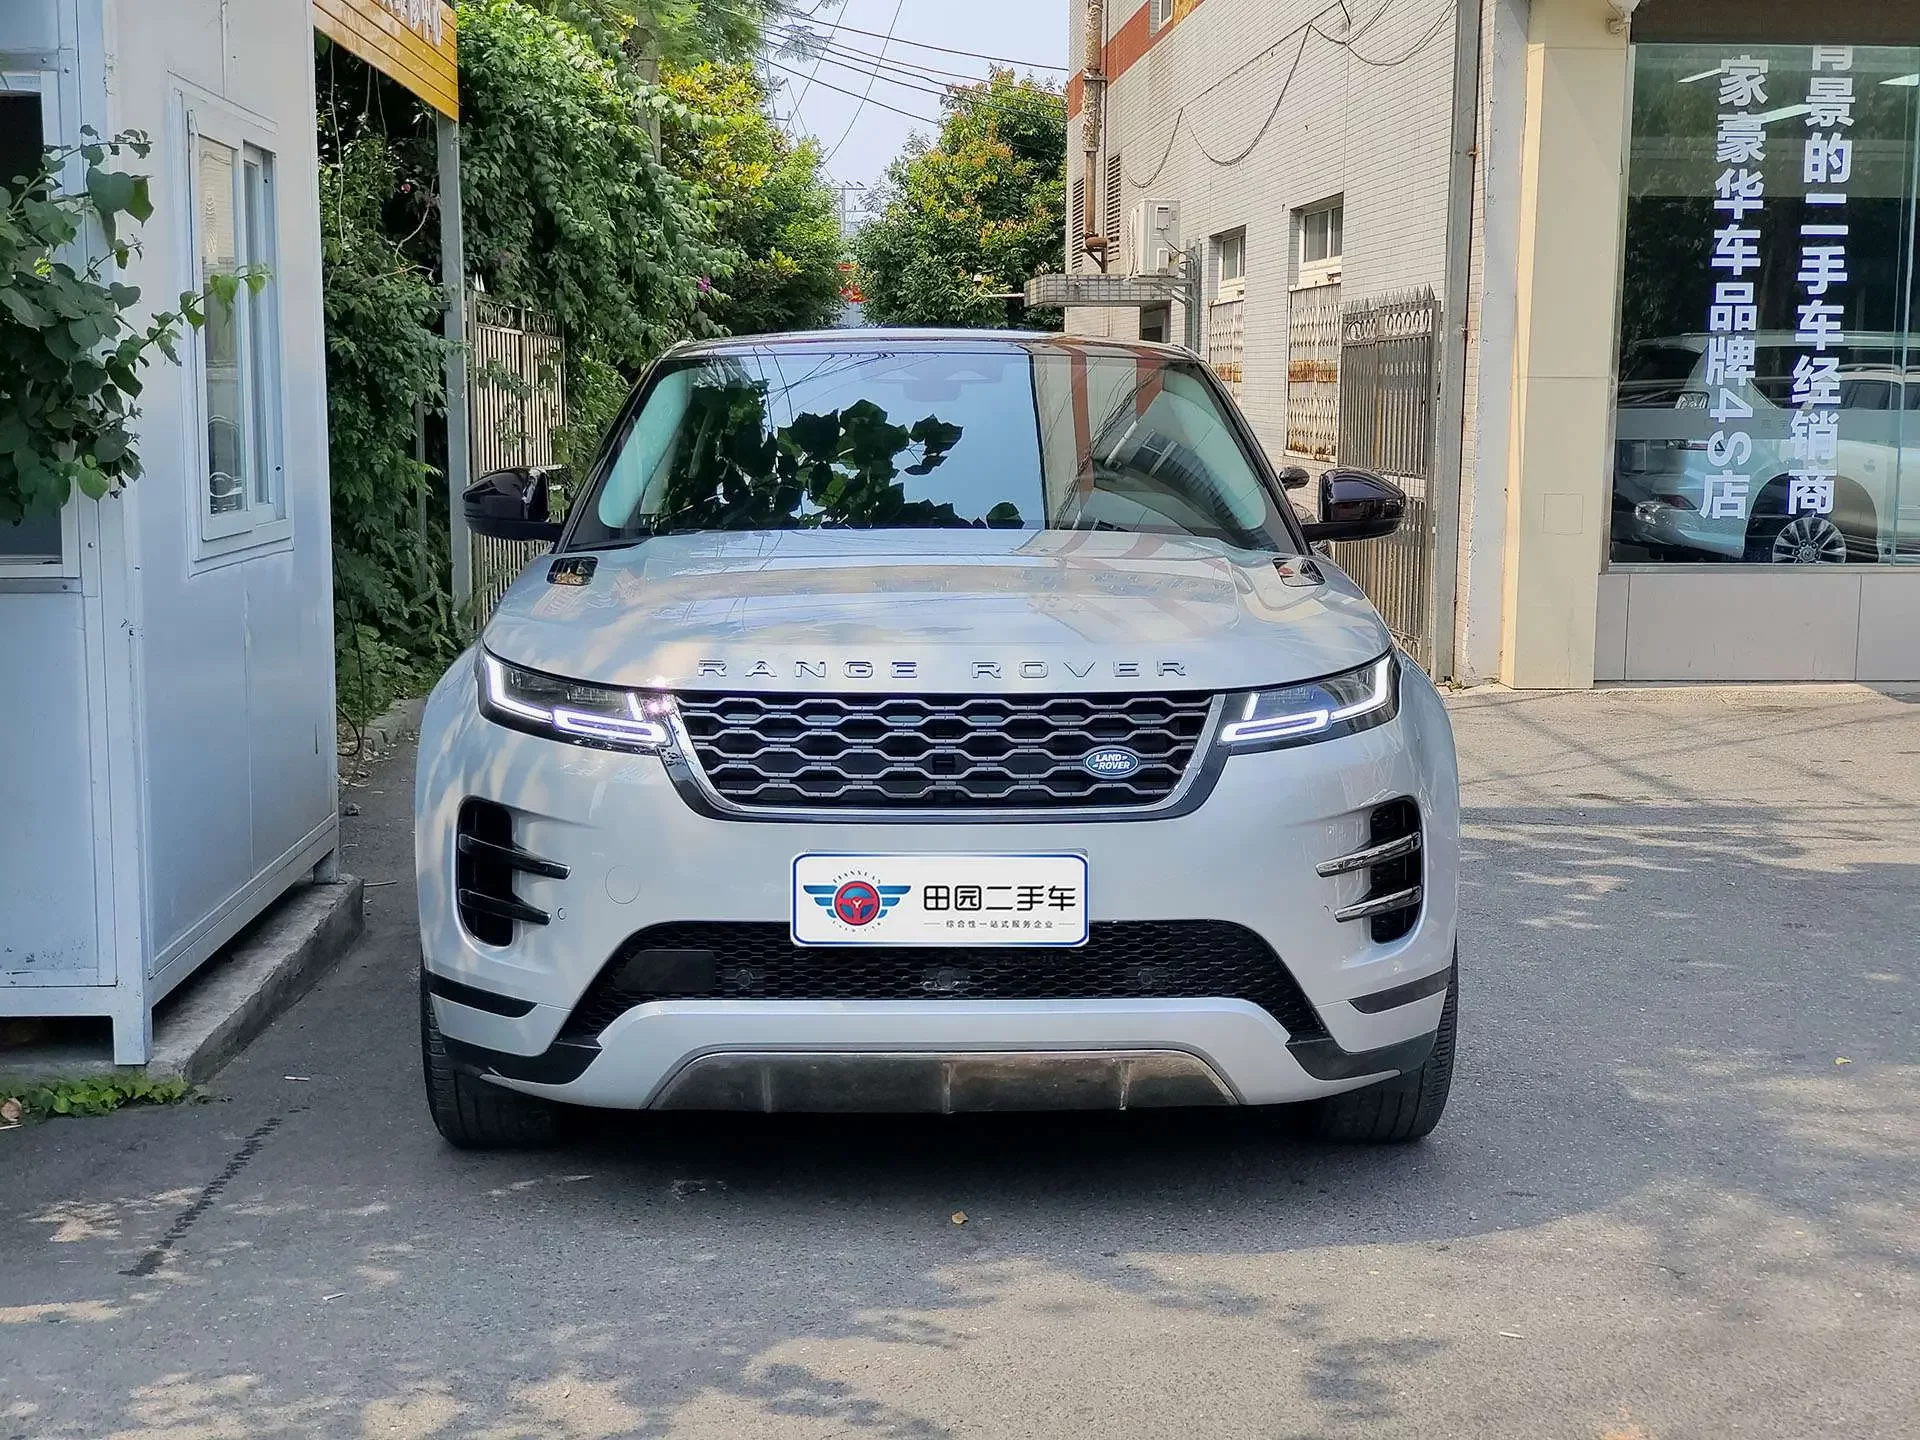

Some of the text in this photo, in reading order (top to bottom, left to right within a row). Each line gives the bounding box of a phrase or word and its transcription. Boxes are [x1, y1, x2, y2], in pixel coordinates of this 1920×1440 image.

[1699, 54, 1768, 520] 家豪华车品牌4S店
[697, 658, 1187, 680] RANGE ROVER
[1095, 753, 1121, 762] LAND
[1098, 761, 1130, 770] ROVER
[923, 885, 1076, 911] 田园二手车
[946, 919, 1053, 929] 综合性一站式服务企业
